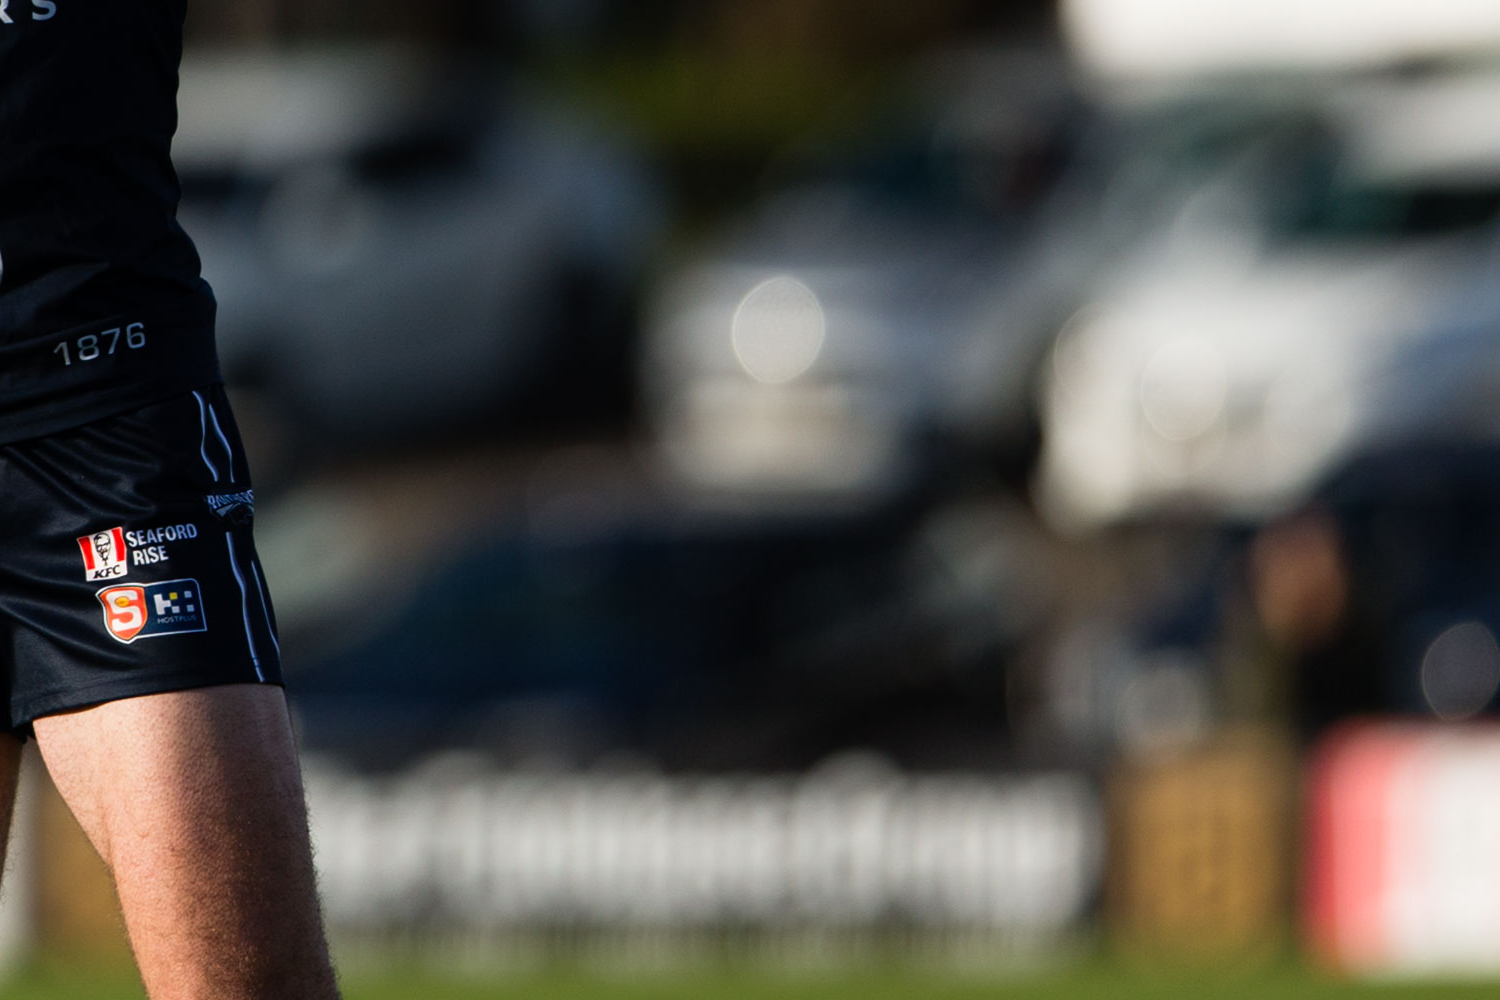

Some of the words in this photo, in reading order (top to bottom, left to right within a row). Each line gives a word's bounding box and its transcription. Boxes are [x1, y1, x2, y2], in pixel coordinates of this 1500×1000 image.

[53, 322, 146, 366] 1876
[125, 523, 198, 548] SEAFORD
[133, 546, 169, 566] RISE
[93, 564, 121, 579] KFC
[105, 589, 143, 633] S
